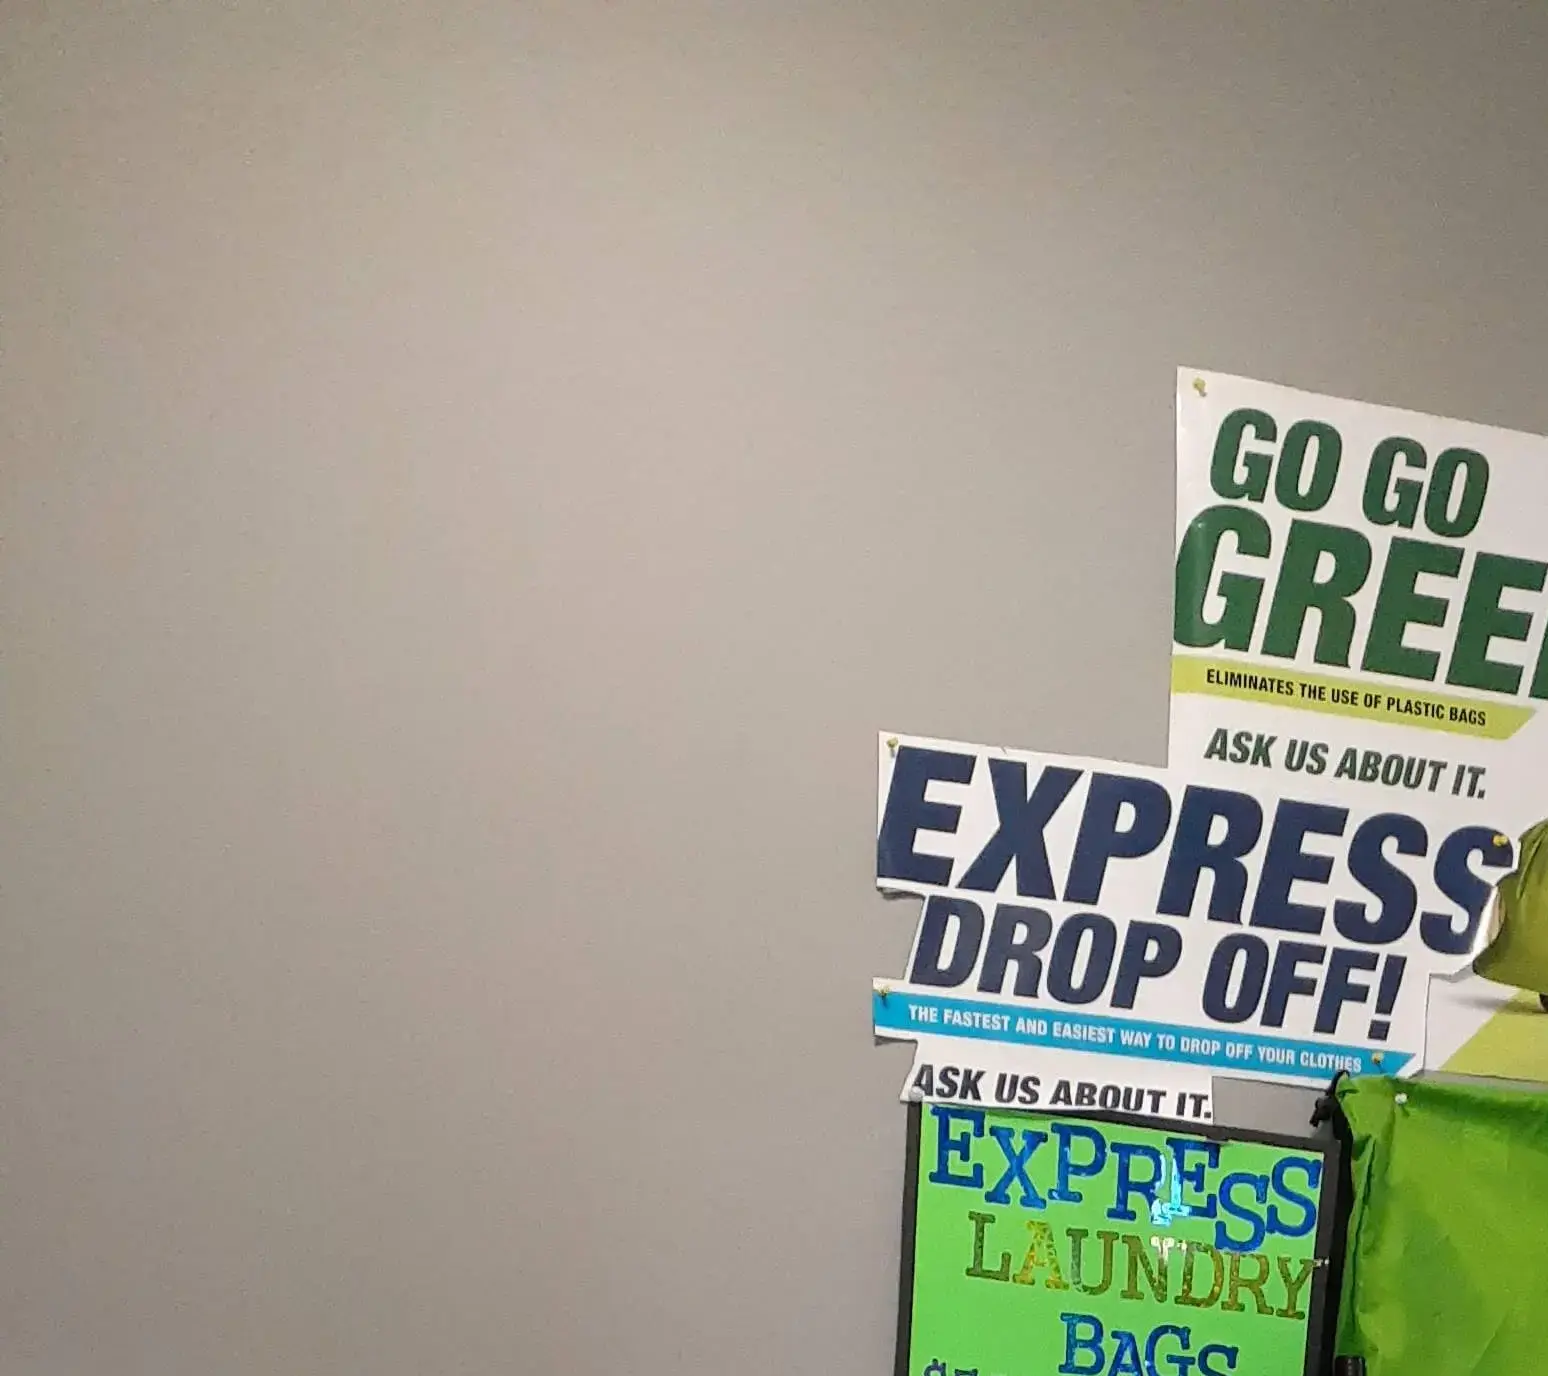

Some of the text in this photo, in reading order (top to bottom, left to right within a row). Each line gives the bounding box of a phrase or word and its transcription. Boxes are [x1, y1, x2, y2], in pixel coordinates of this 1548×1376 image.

[1209, 407, 1490, 538] GO GO
[1206, 668, 1487, 727] ELIMINATES THE USE OF PLASTIC BAGS
[1203, 727, 1487, 800] ASK US ABOUT IT.
[875, 745, 1518, 957] EXPRESS
[908, 894, 1408, 1041] DROP OFF!
[908, 1004, 1363, 1074] THE FASTEST AND EASIEST WAY TO DROP OFF YOUR CLOTHES
[913, 1063, 1213, 1120] ASK US ABOUT IT.
[928, 1105, 1323, 1254] EXPRESS
[965, 1211, 1318, 1321] LAUNDRY
